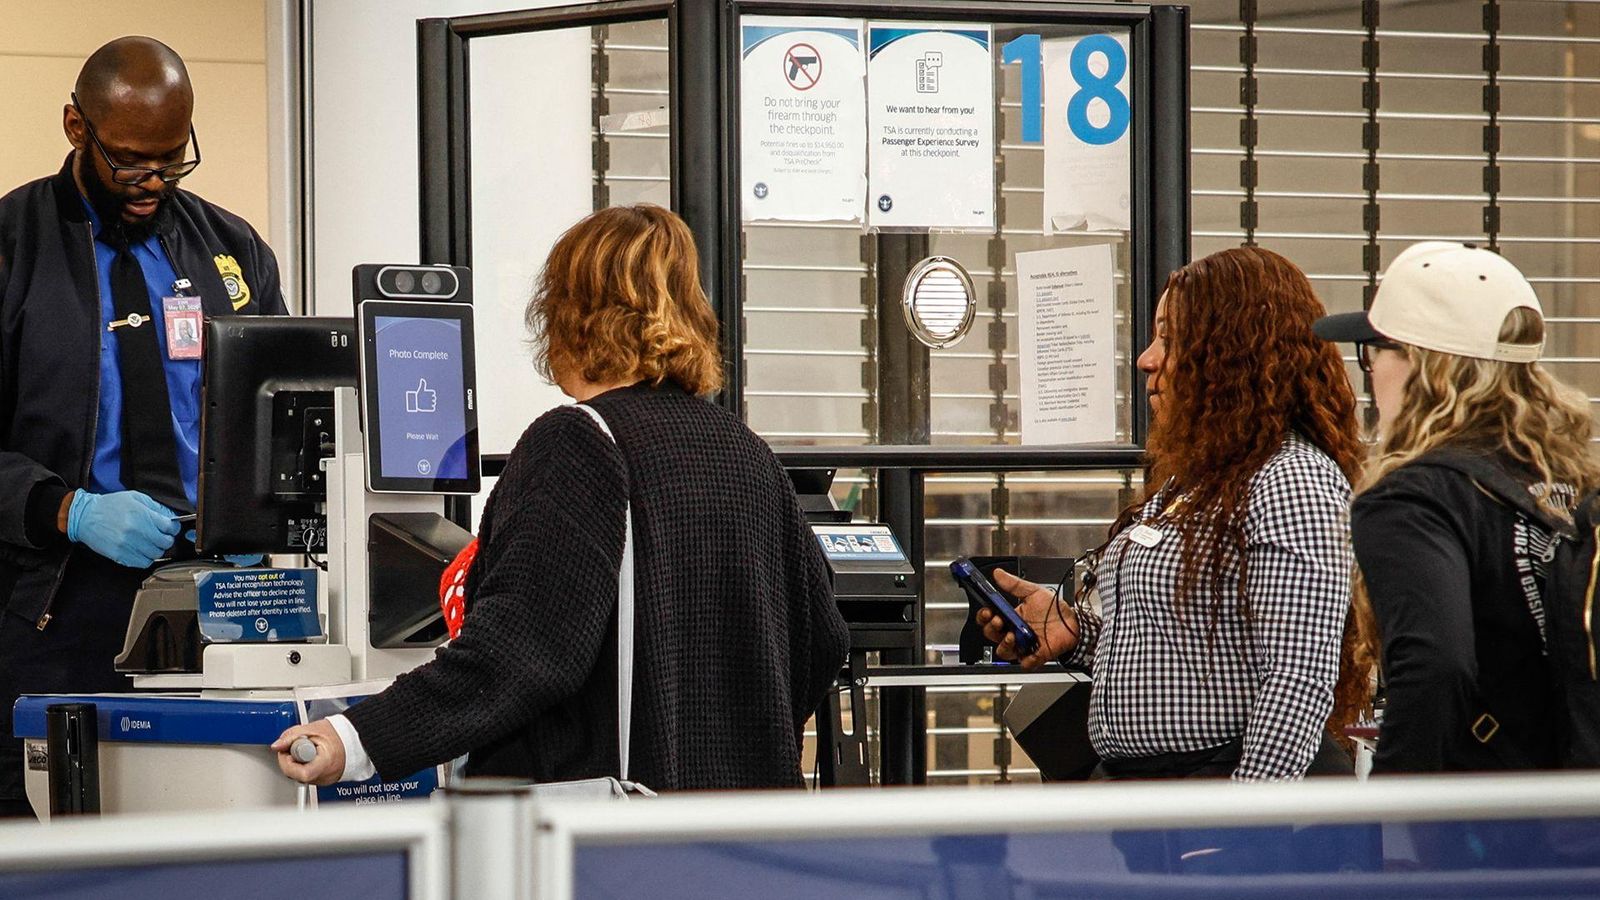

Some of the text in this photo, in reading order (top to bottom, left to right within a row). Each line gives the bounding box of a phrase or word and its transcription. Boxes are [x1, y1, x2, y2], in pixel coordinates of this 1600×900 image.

[1002, 34, 1130, 145] 18
[764, 97, 840, 110] Do not bring your
[768, 110, 836, 123] firearm through
[942, 106, 958, 114] from
[960, 107, 975, 115] you!
[770, 123, 835, 135] the checkpoint.
[883, 126, 896, 134] TSA
[904, 126, 934, 136] currently
[936, 128, 972, 136] conducting
[882, 137, 979, 147] Passenger Experience Survey
[909, 148, 921, 156] this
[923, 149, 960, 158] checkpoint.
[389, 349, 449, 360] Photo Complete
[1514, 523, 1529, 554] 2014
[1516, 558, 1532, 572] IN
[131, 721, 151, 729] IDEMIA
[337, 781, 419, 796] You will not lose your
[356, 795, 376, 806] place
[386, 793, 402, 802] line.
